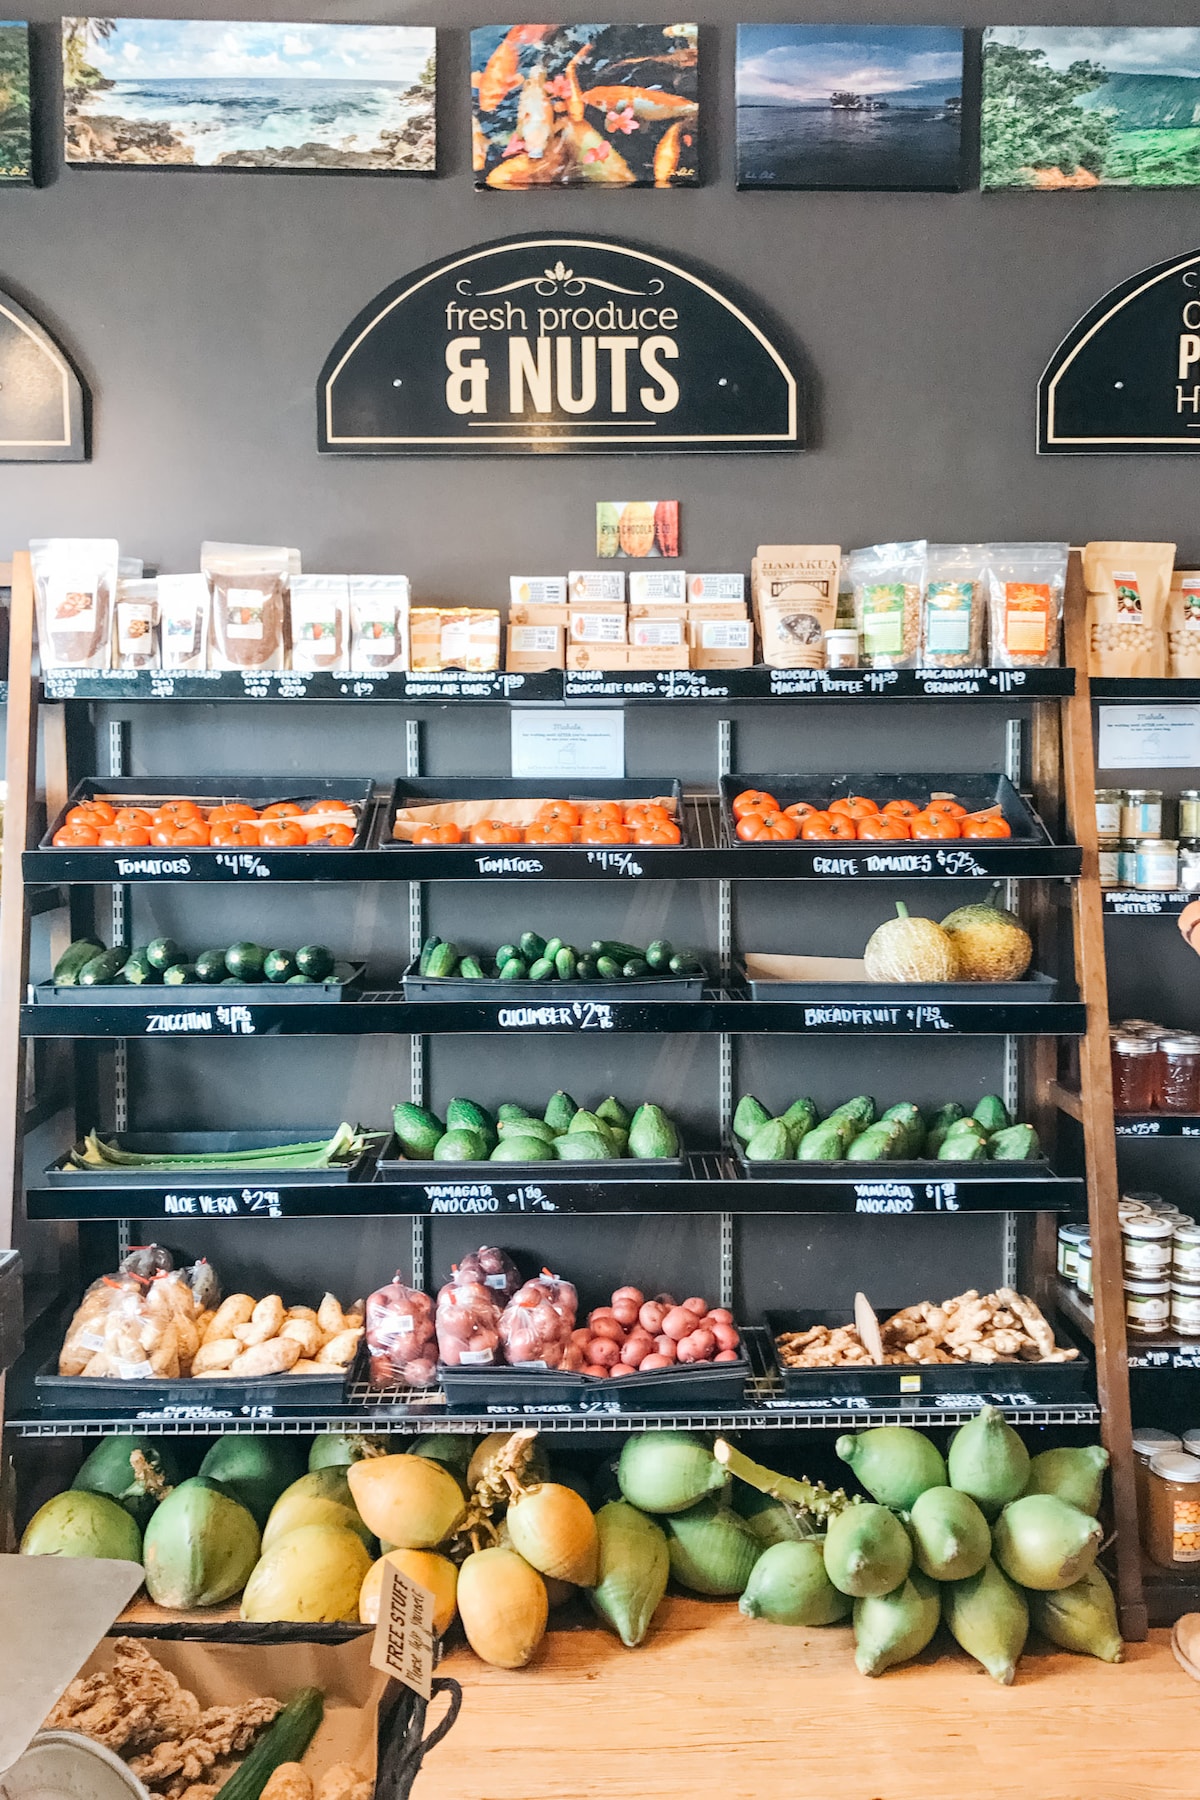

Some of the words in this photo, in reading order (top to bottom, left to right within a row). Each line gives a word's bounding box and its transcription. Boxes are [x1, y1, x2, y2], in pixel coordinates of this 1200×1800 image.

[445, 301, 528, 330] fresh
[538, 301, 679, 337] produce
[445, 337, 489, 415] &
[508, 335, 680, 414] NUTS
[719, 583, 742, 594] STYLE
[567, 671, 604, 682] PUNA
[770, 670, 830, 681] CHOCOLATE
[915, 669, 988, 680] MACADAMIA
[461, 683, 492, 696] BARS
[566, 682, 623, 695] CHOCOLATE
[624, 682, 657, 694] BARS
[820, 679, 864, 694] TOFFEE
[924, 681, 980, 694] GRANOLA
[114, 857, 192, 875] TOMATOES
[475, 856, 544, 874] TOMATOES
[812, 856, 859, 876] GRAPE
[862, 855, 933, 872] TOMATOES
[498, 1006, 574, 1027] CUCUMBER
[804, 1008, 901, 1027] BREADFRUIT
[423, 1184, 493, 1199] YAMAGATA
[854, 1183, 915, 1199] YAMAGATA
[164, 1195, 198, 1213] ALOE
[198, 1195, 239, 1215] VERA
[430, 1197, 500, 1213] AVOCADO
[855, 1198, 915, 1213] AVOCADO
[184, 1411, 234, 1420] POTATO
[487, 1405, 520, 1414] RED
[523, 1404, 573, 1414] POTATO
[390, 1574, 409, 1627] STUFF
[386, 1624, 405, 1672] FREE
